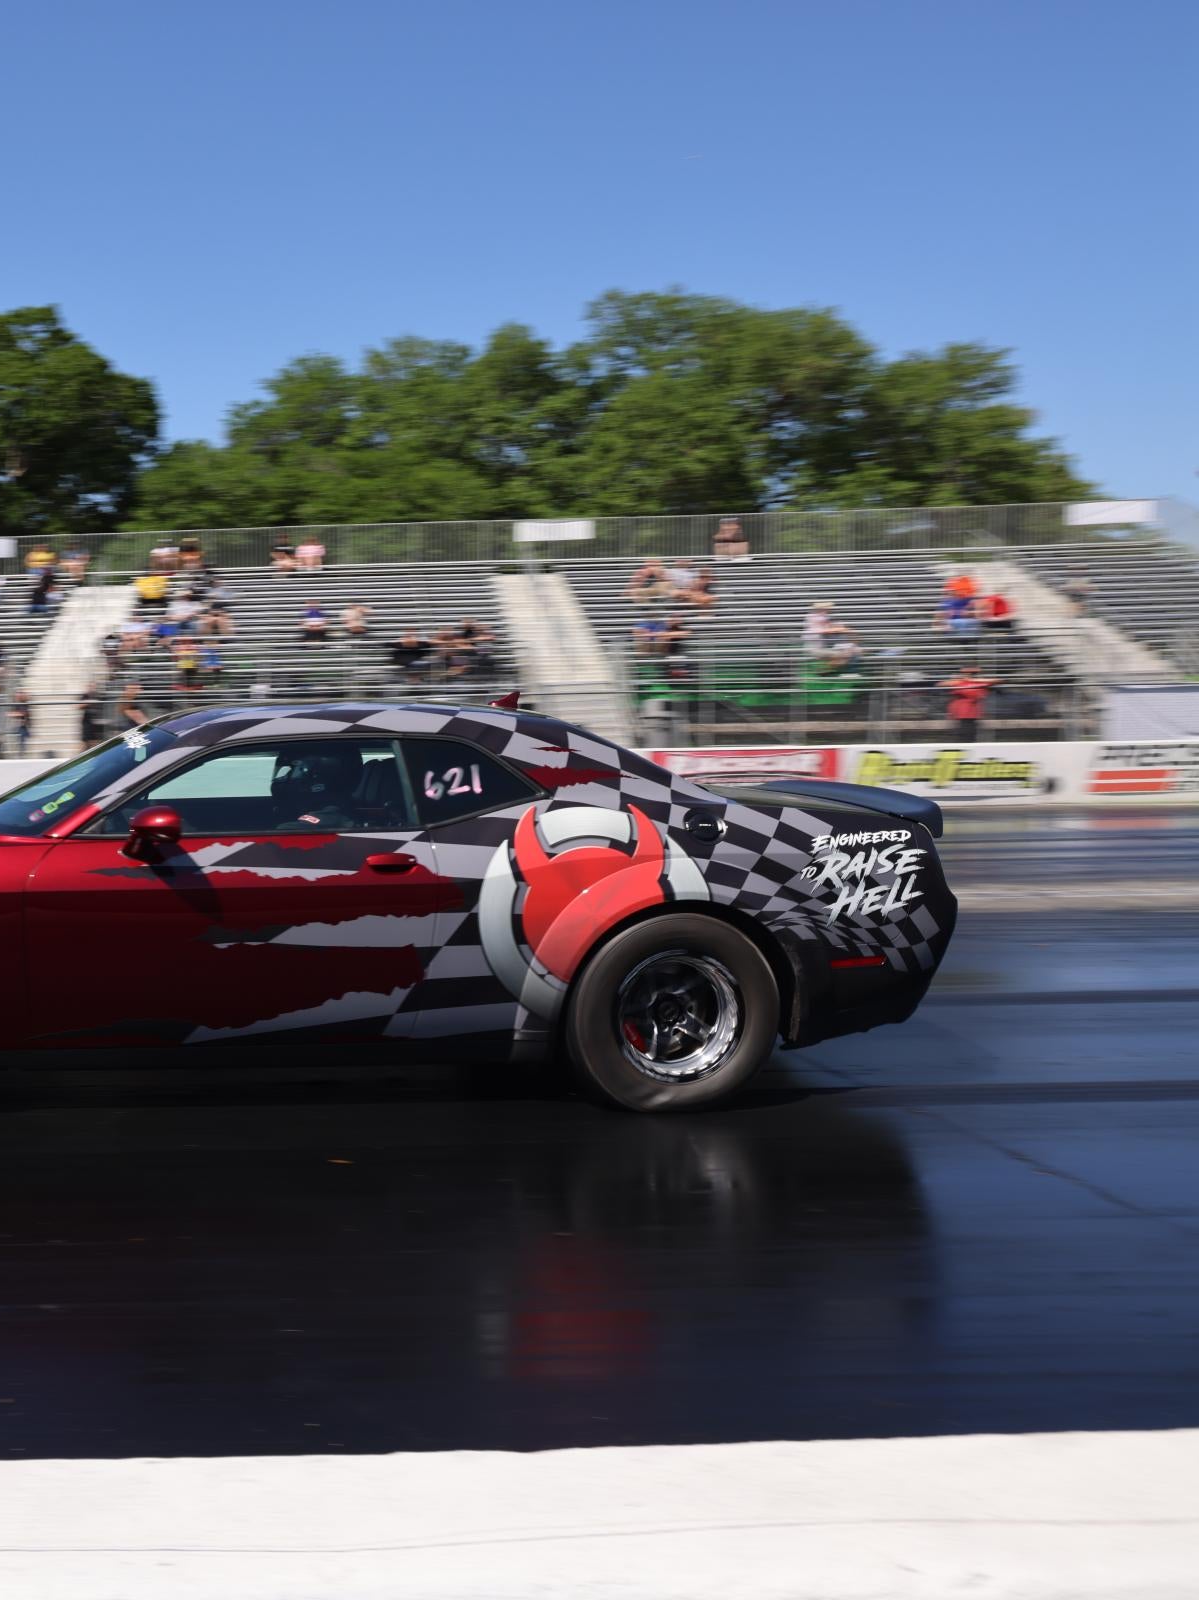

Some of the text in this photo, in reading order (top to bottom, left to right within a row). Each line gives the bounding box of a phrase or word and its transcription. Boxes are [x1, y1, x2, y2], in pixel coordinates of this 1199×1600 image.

[424, 764, 482, 800] 621
[809, 829, 912, 854] ENGINEERED
[800, 844, 928, 894] TO RAISE
[823, 873, 924, 928] HELL
